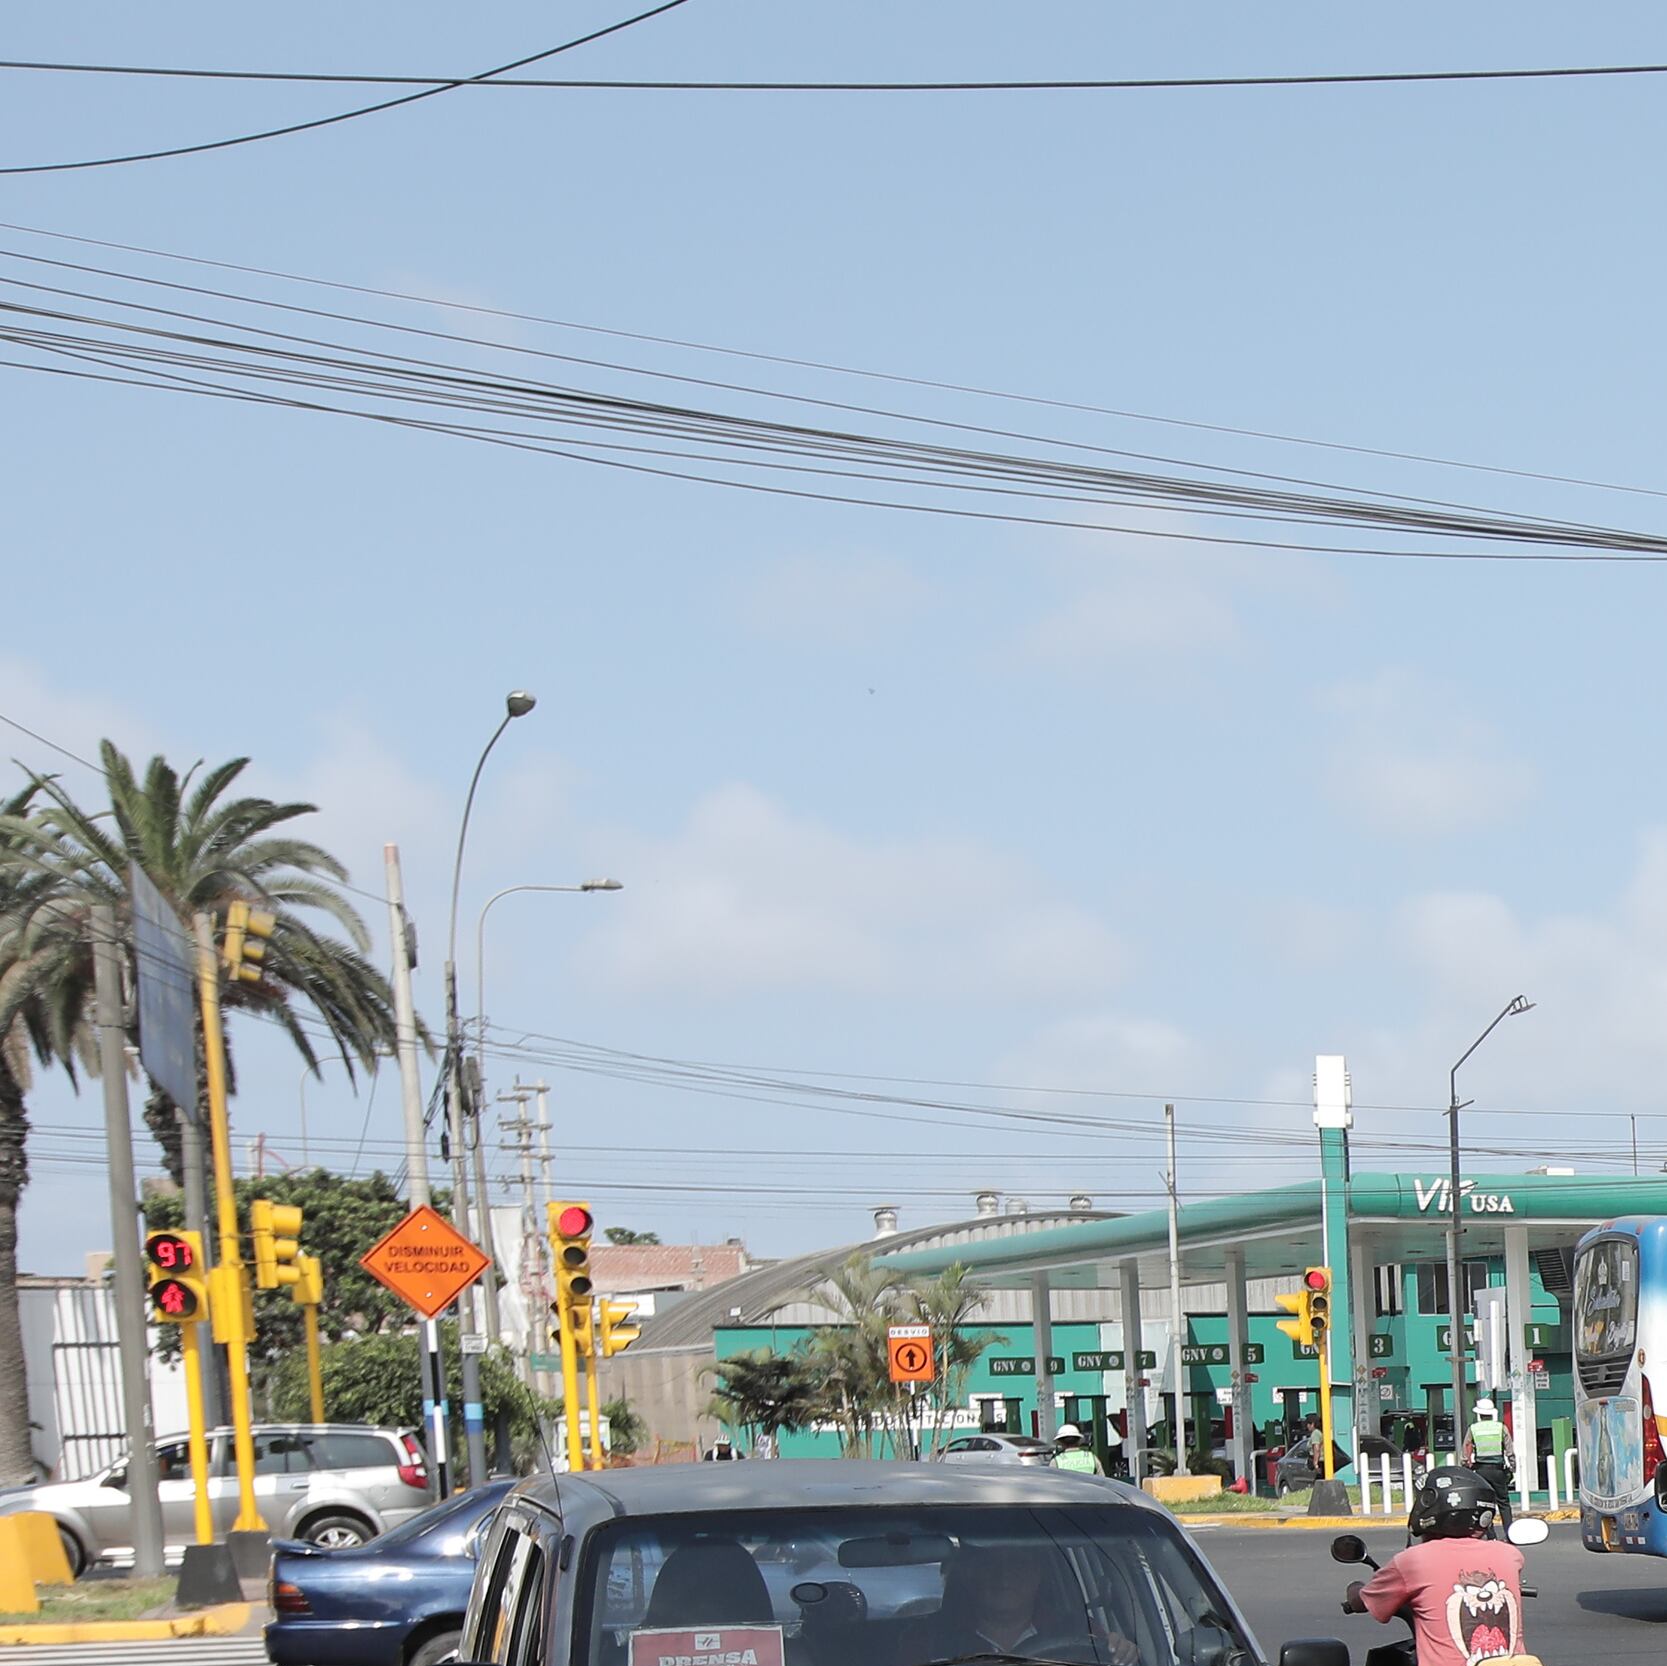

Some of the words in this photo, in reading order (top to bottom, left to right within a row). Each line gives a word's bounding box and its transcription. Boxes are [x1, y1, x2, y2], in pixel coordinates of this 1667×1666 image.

[1470, 1194, 1514, 1213] USA
[157, 1241, 192, 1268] 97
[388, 1246, 465, 1258] DISMINUIR
[385, 1261, 470, 1273] VELOCIDAD
[890, 1328, 928, 1336] DESVIO
[1532, 1328, 1541, 1345] 1
[1374, 1338, 1384, 1354] 3
[1077, 1354, 1104, 1367] GNV
[1140, 1353, 1148, 1366] 7
[1182, 1346, 1207, 1361] GNV
[1247, 1347, 1256, 1362] 5
[993, 1360, 1017, 1372] GNV
